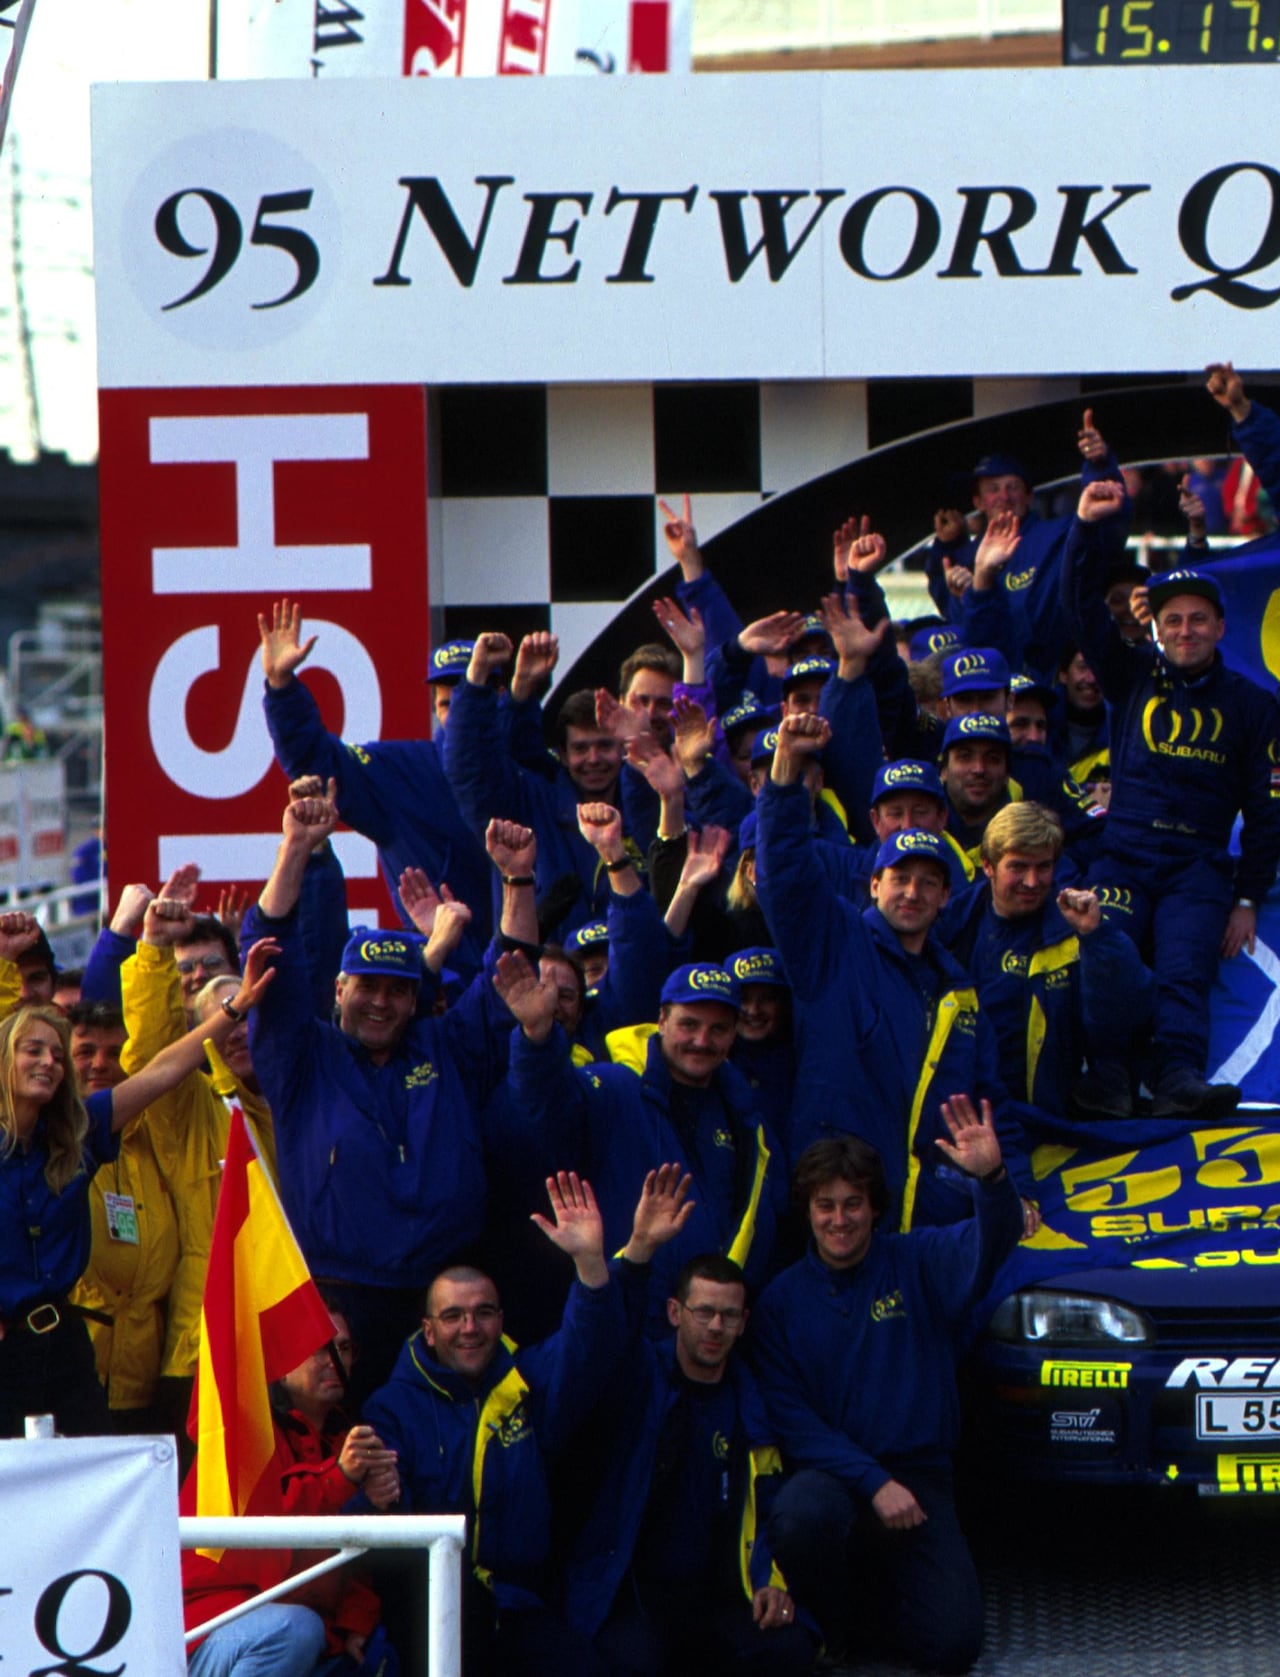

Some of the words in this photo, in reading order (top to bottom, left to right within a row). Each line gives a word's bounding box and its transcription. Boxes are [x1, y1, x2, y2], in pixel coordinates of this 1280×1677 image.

[154, 187, 321, 311] 95
[373, 176, 1152, 288] NETWORK
[1157, 743, 1227, 764] SUBARU
[369, 941, 407, 956] 555
[740, 954, 775, 972] 555
[697, 969, 732, 983] 555
[1040, 1359, 1133, 1389] PIRELLI
[1204, 1401, 1228, 1433] L
[29, 1568, 132, 1677] Q
